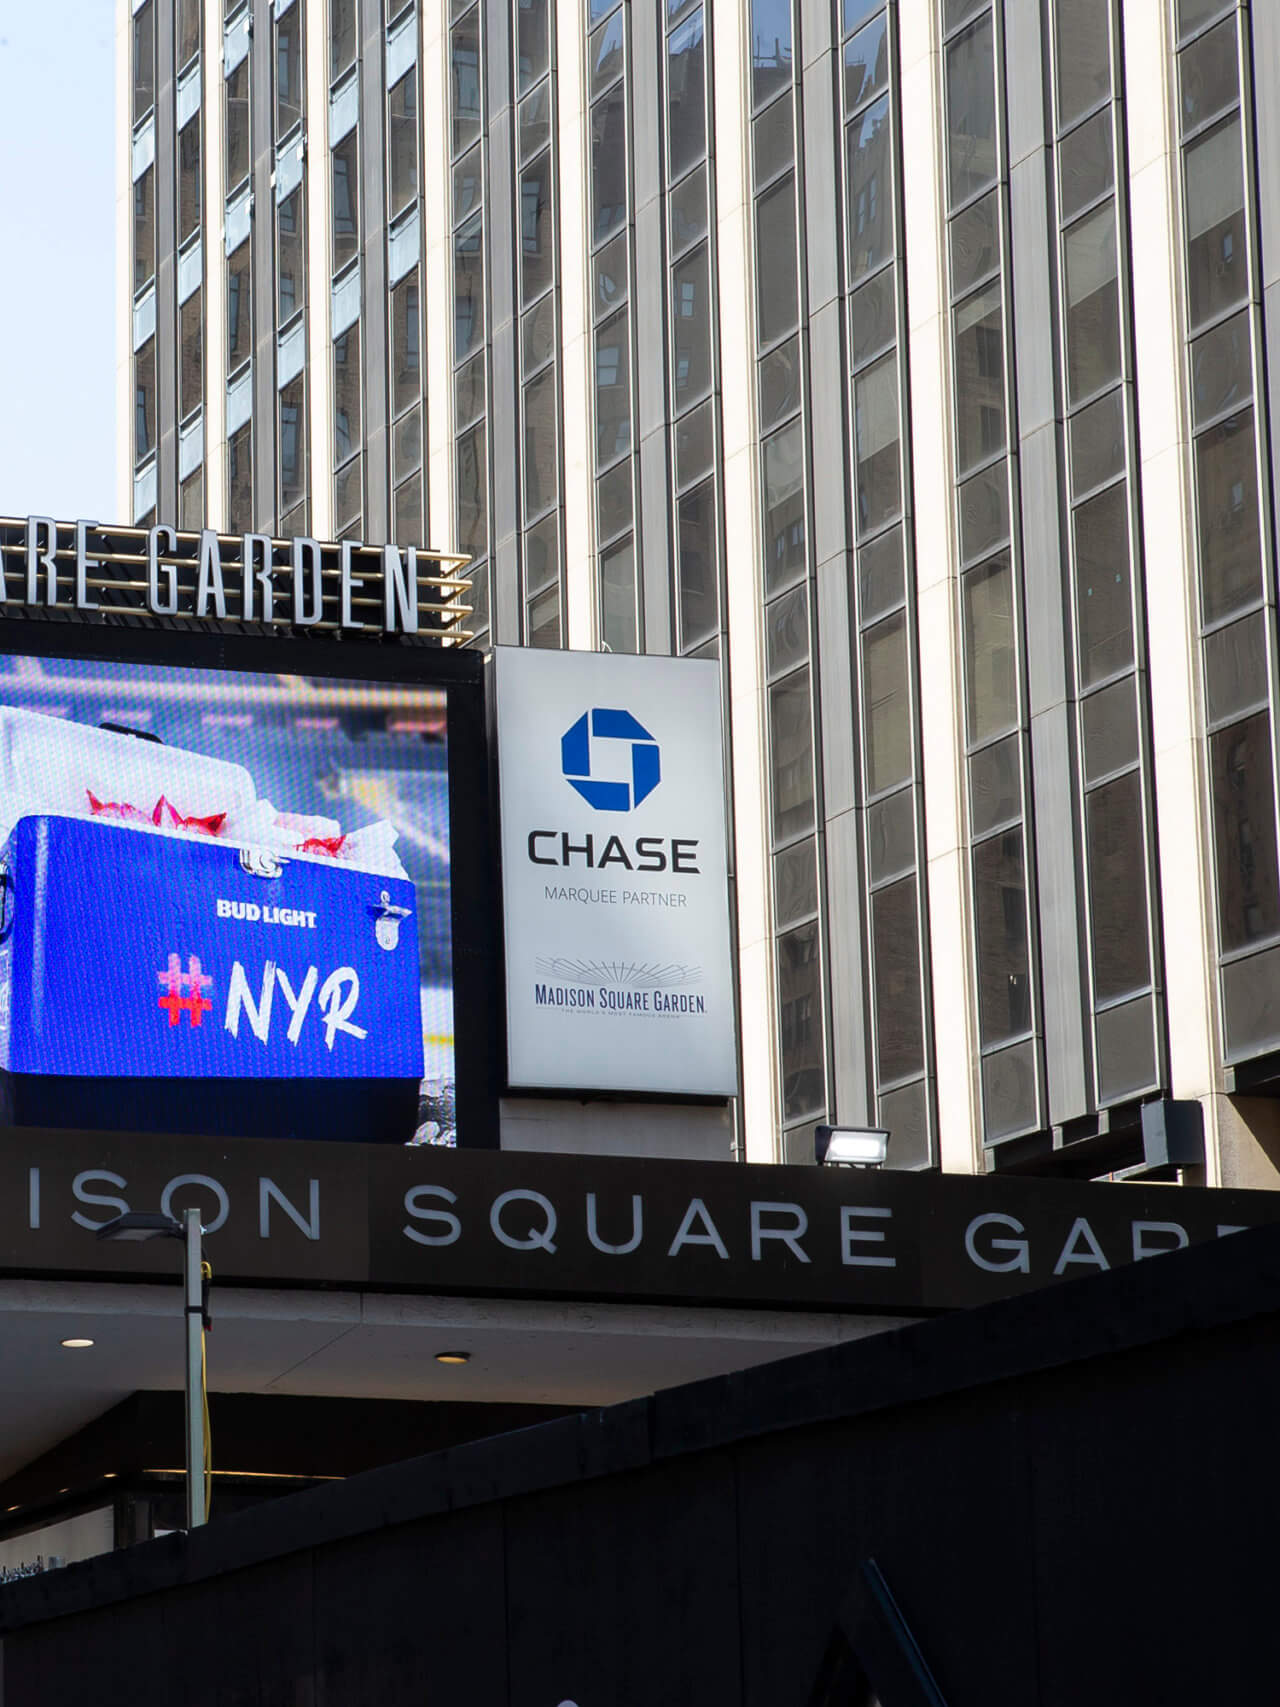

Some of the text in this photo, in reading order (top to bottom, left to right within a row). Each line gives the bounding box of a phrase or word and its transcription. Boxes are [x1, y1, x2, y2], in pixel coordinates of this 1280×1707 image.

[147, 524, 417, 633] GARDEN
[528, 830, 701, 874] CHASE
[217, 898, 317, 929] BUD LIGHT
[545, 886, 687, 907] MARQUEE PARTNER
[158, 953, 368, 1053] #NYR
[535, 984, 595, 1008] MADISON
[599, 987, 649, 1011] SQUARE
[403, 1184, 896, 1268] SQUARE
[965, 1211, 1251, 1276] GAR
